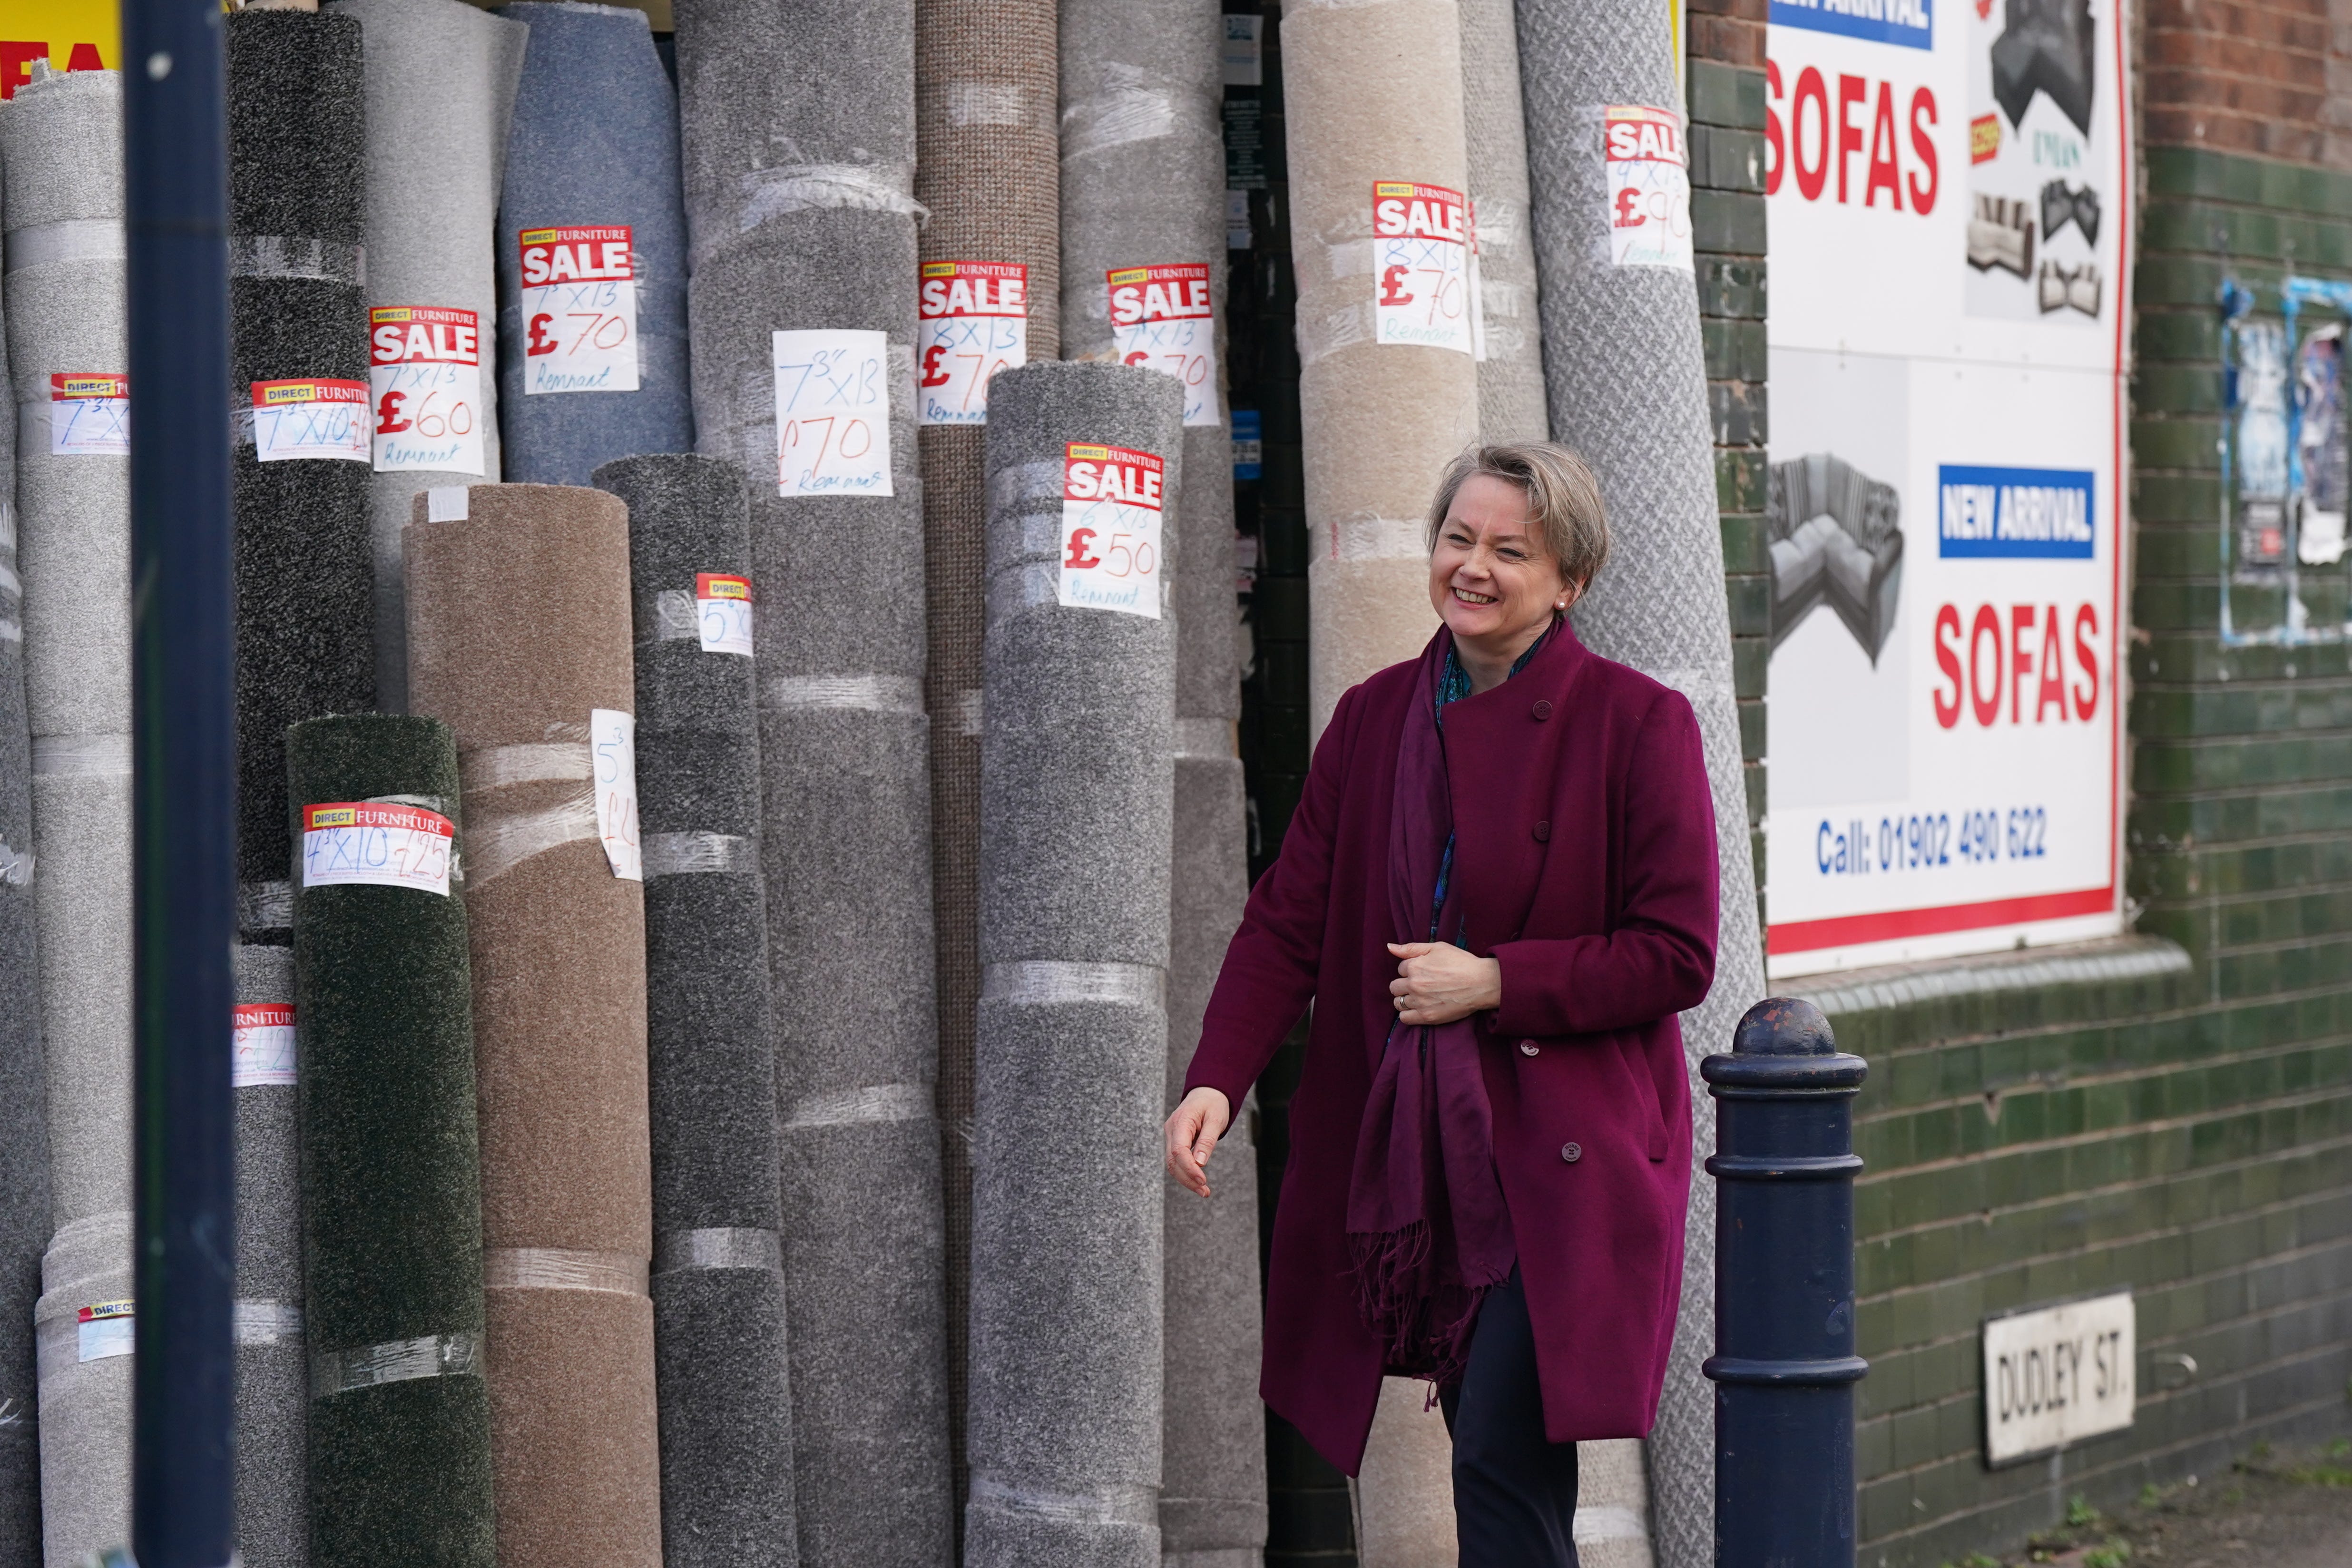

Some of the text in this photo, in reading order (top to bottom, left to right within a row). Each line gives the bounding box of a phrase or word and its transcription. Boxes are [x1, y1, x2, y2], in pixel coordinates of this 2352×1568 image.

[1609, 123, 1684, 165] SALE
[1766, 58, 1939, 216] SOFAS
[1414, 186, 1463, 206] FURNITURE
[525, 229, 627, 242] DIRECT FURNITURE
[1377, 199, 1464, 243] SALE
[523, 242, 631, 284] SALE
[925, 265, 1022, 277] DIRECT FURNITURE
[1113, 267, 1206, 283] DIRECT FURNITURE
[921, 278, 1023, 315] SALE
[1113, 280, 1211, 323] SALE
[375, 310, 475, 325] DIRECT FURNITURE
[373, 324, 478, 363] SALE
[68, 383, 111, 392] DIRECT
[269, 388, 311, 399] DIRECT
[1072, 448, 1161, 471] DIRECT FURNITURE
[1068, 461, 1161, 507] SALE
[1941, 483, 2092, 543] NEW ARRIVAL
[1065, 528, 1154, 577] £50
[713, 584, 743, 595] DIRECT
[1932, 603, 2099, 729] SOFAS
[314, 811, 442, 834] DIRECT FURNITURE
[1816, 805, 2047, 876] Call: 01902 490 622
[1998, 1338, 2083, 1423] DUDLEY
